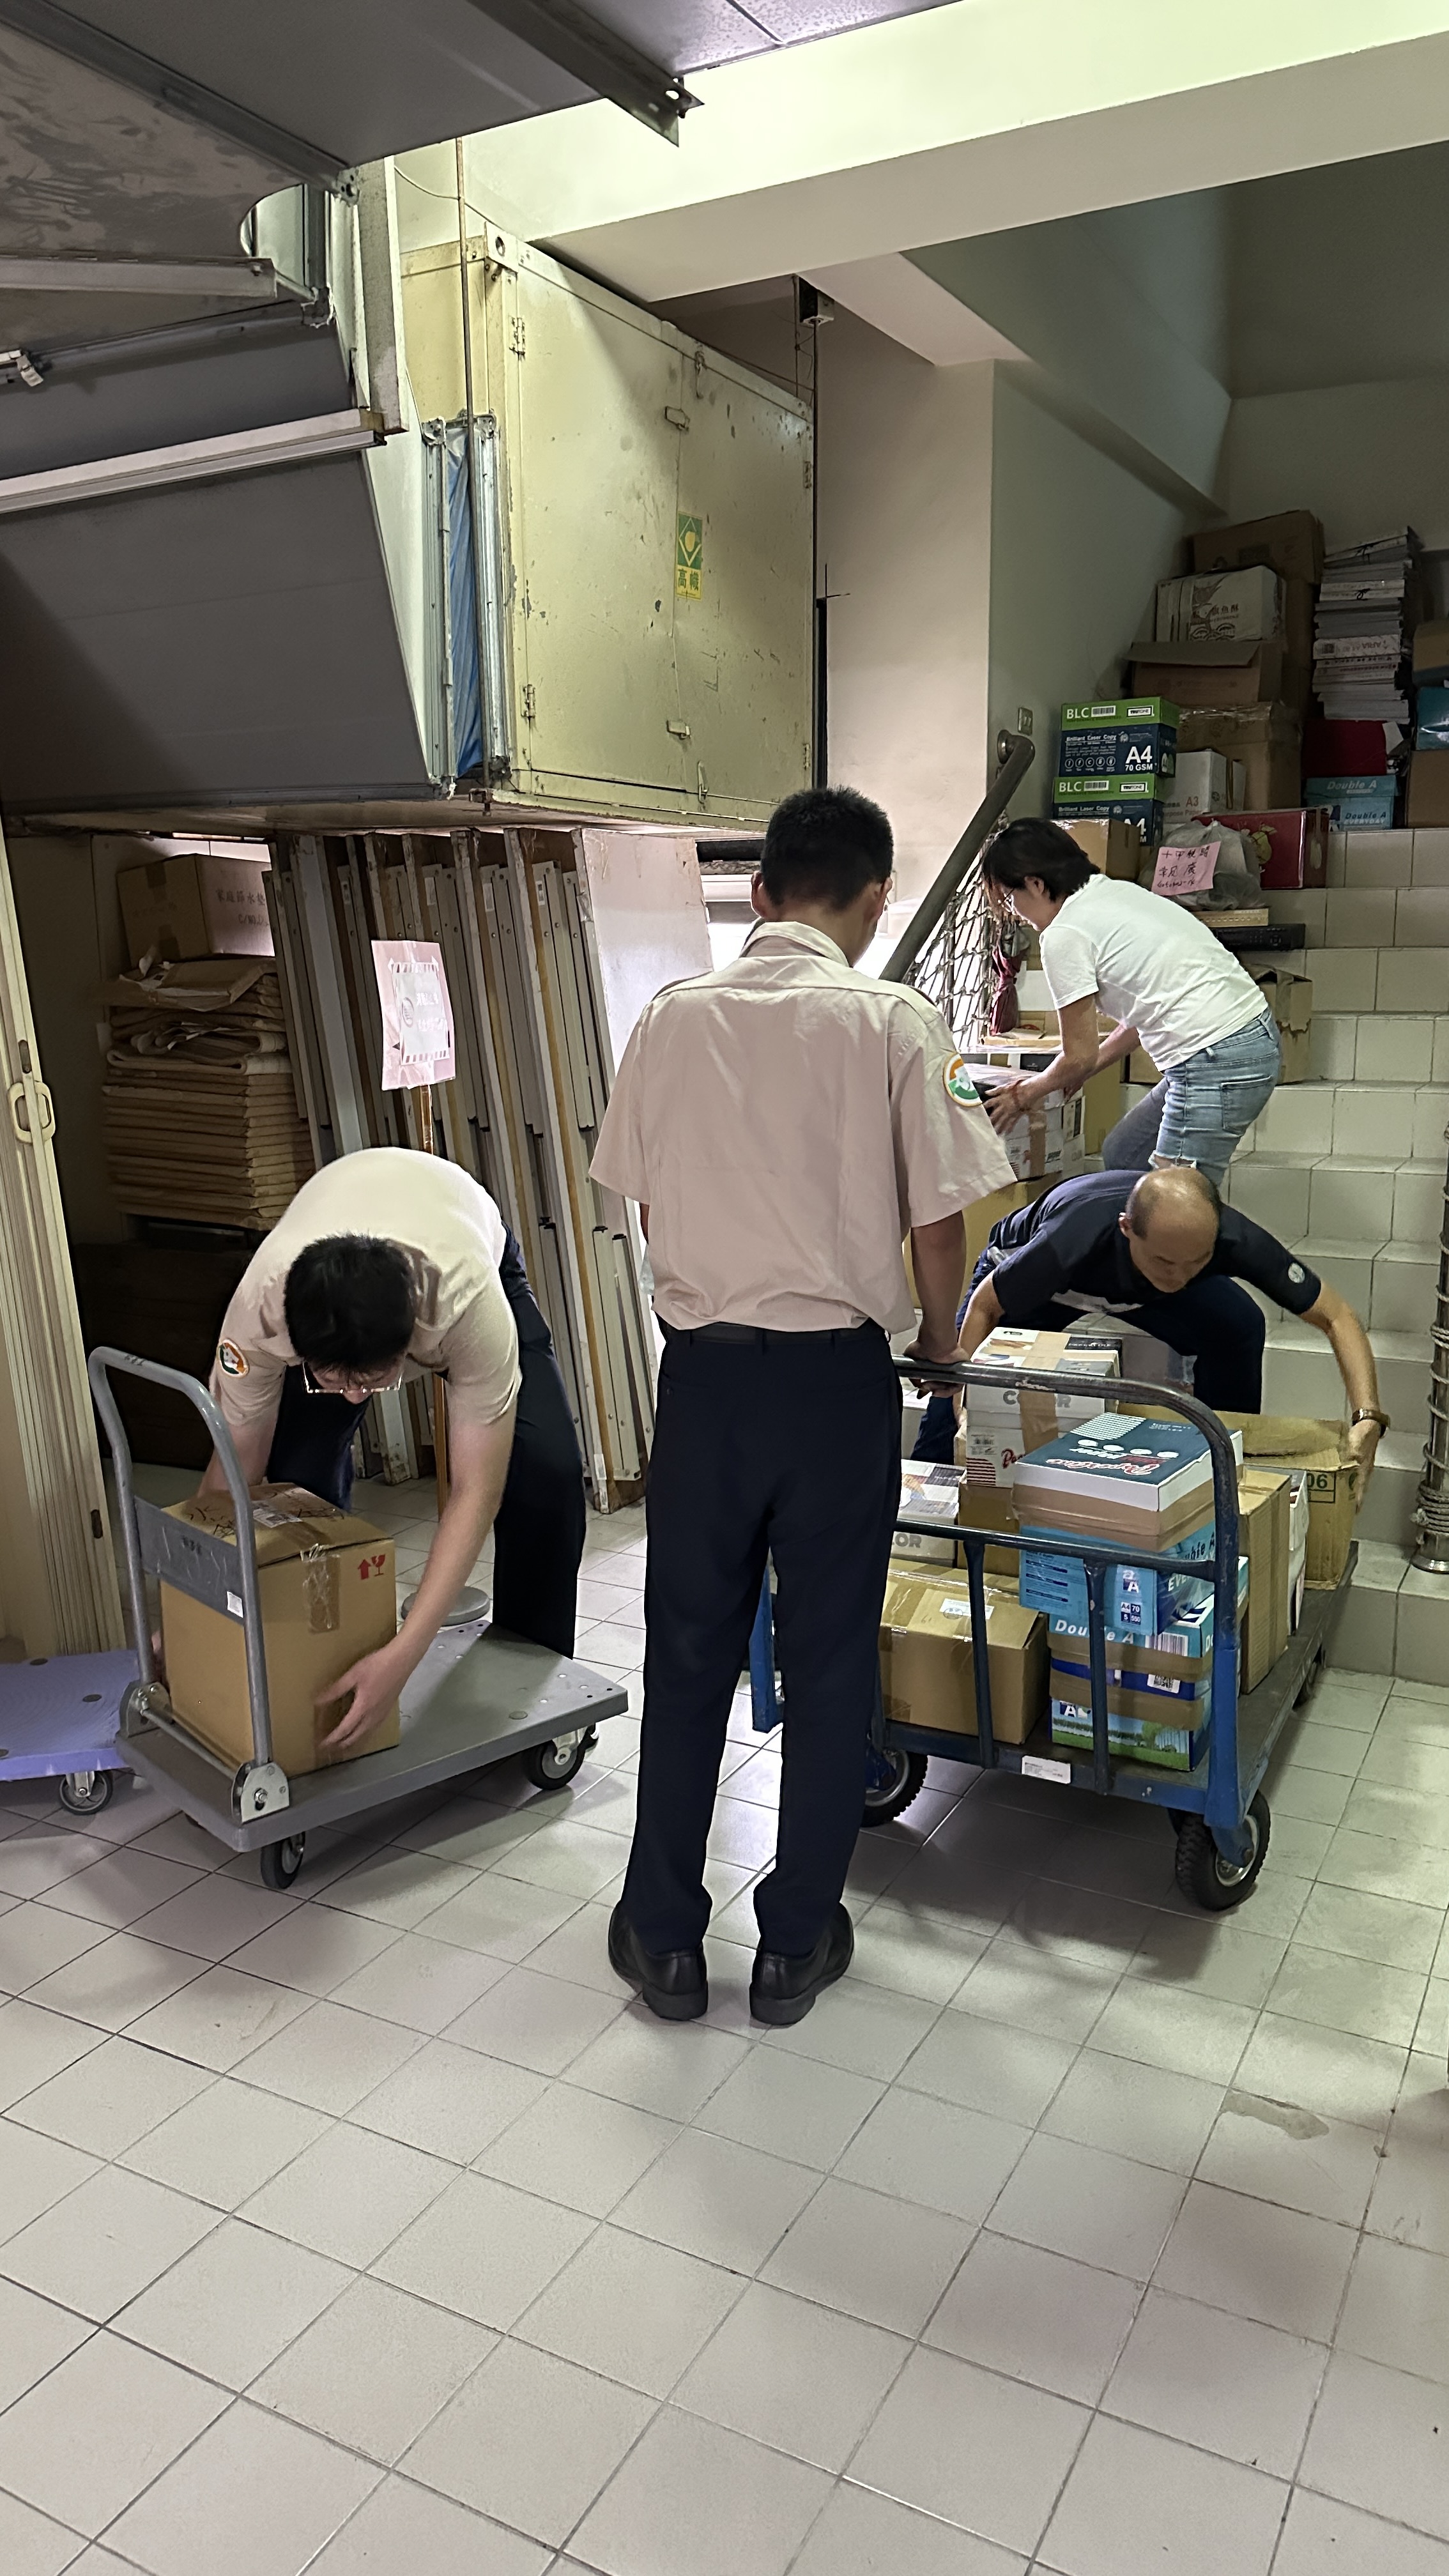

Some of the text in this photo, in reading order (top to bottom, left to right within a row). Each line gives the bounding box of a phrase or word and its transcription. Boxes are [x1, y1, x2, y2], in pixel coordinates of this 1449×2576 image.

[1066, 707, 1089, 719] BLC
[1125, 745, 1153, 764] A4
[1135, 763, 1153, 771] GSM
[1059, 781, 1082, 792] BLC
[1327, 779, 1377, 790] Double A
[1186, 796, 1199, 807] A3
[1055, 1619, 1134, 1644] Doue A
